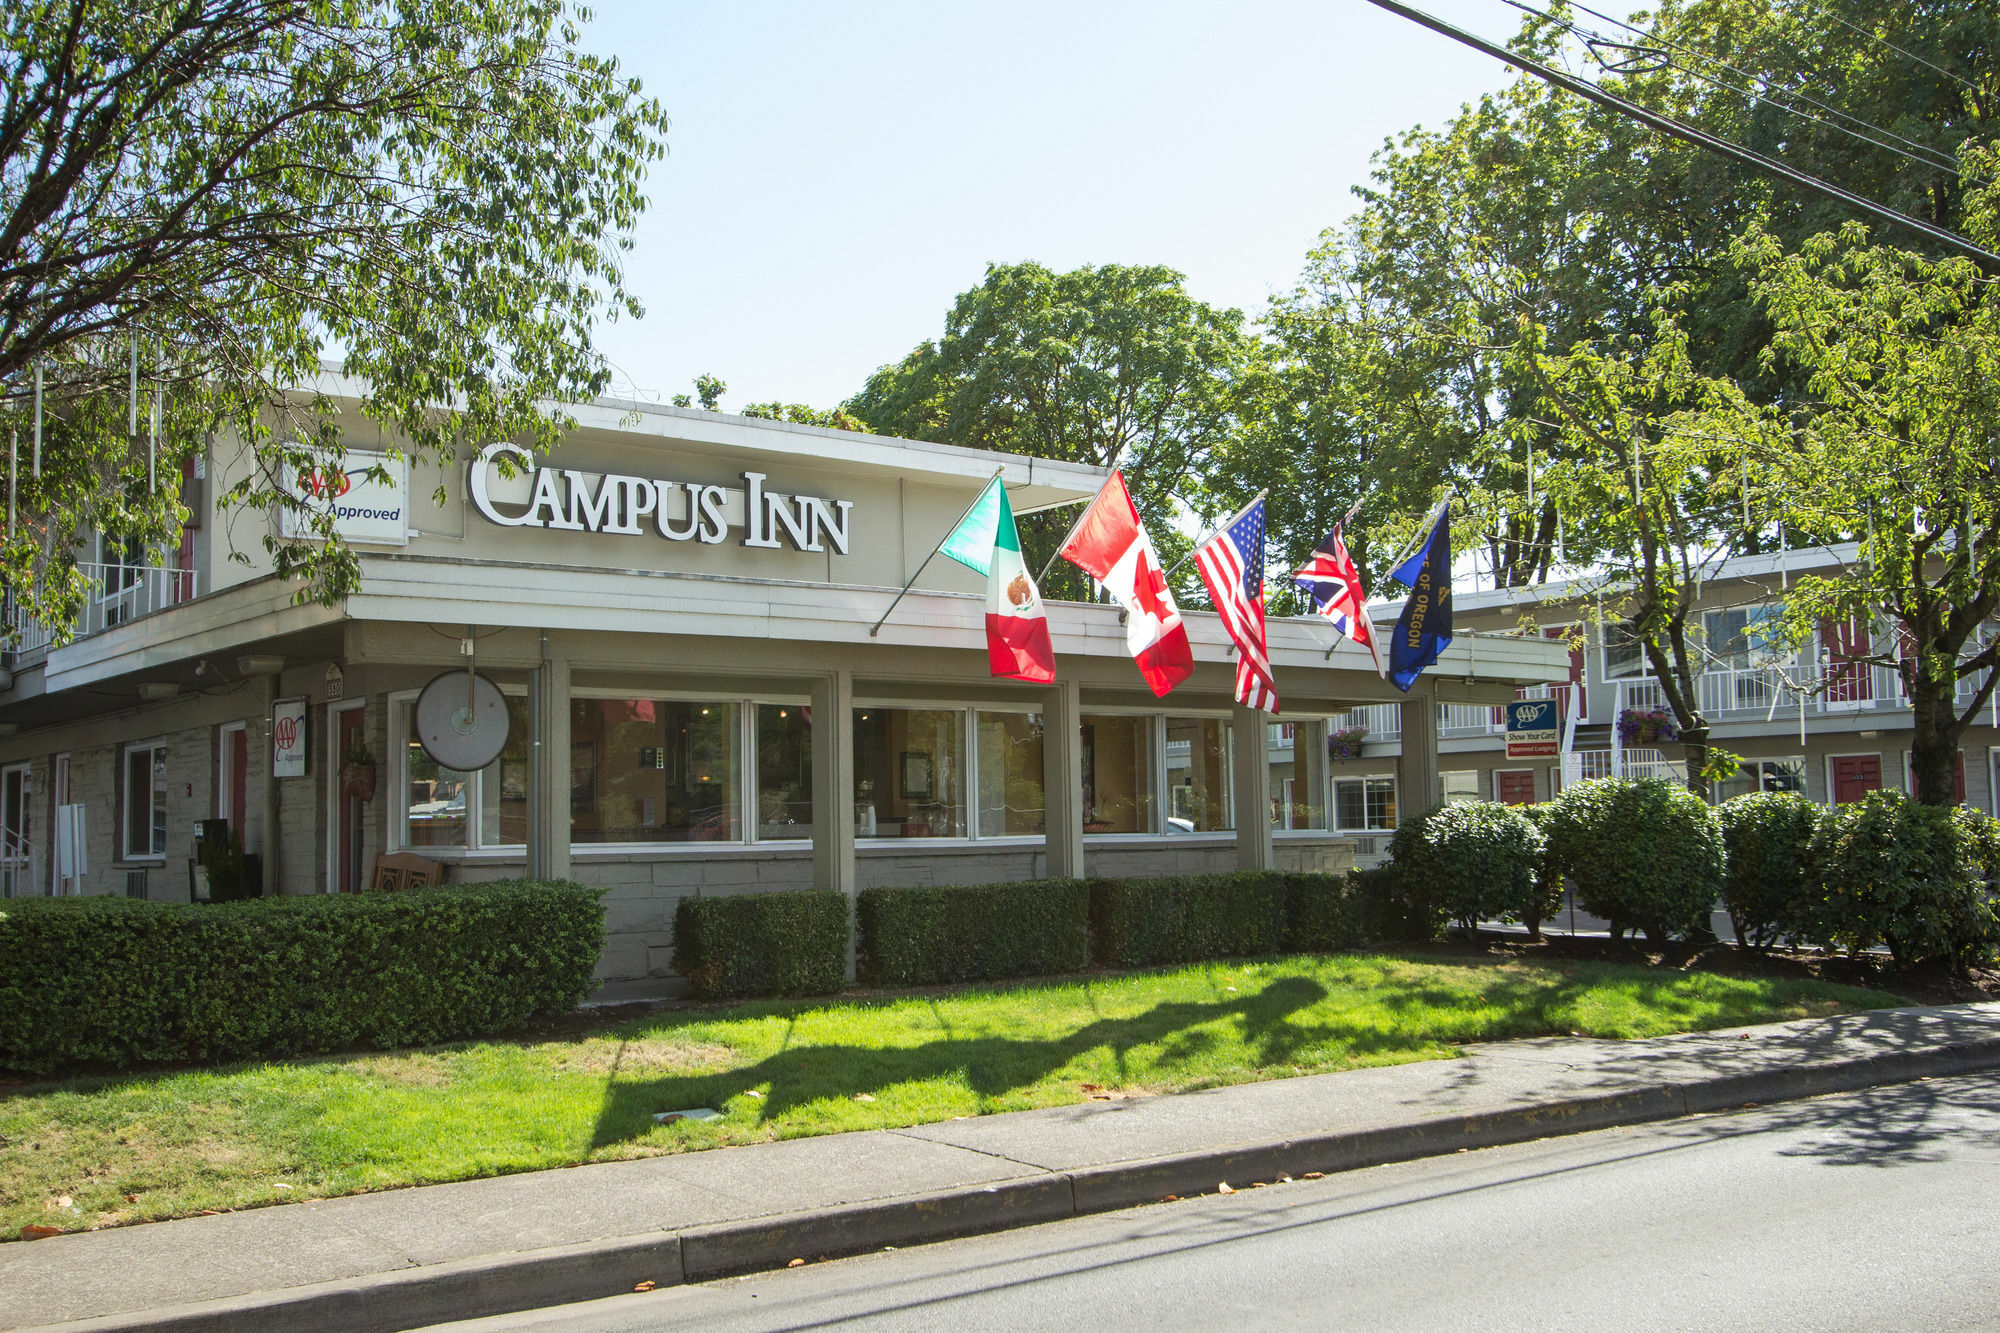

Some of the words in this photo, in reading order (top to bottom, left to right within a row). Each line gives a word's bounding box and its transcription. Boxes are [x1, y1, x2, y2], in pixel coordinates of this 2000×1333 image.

[326, 503, 401, 521] Approved
[1419, 573, 1430, 591] OF
[1408, 594, 1430, 648] OREGON
[1517, 705, 1538, 722] AAA
[1508, 733, 1526, 741] Show
[1527, 732, 1540, 740] Your
[1541, 731, 1556, 740] Card
